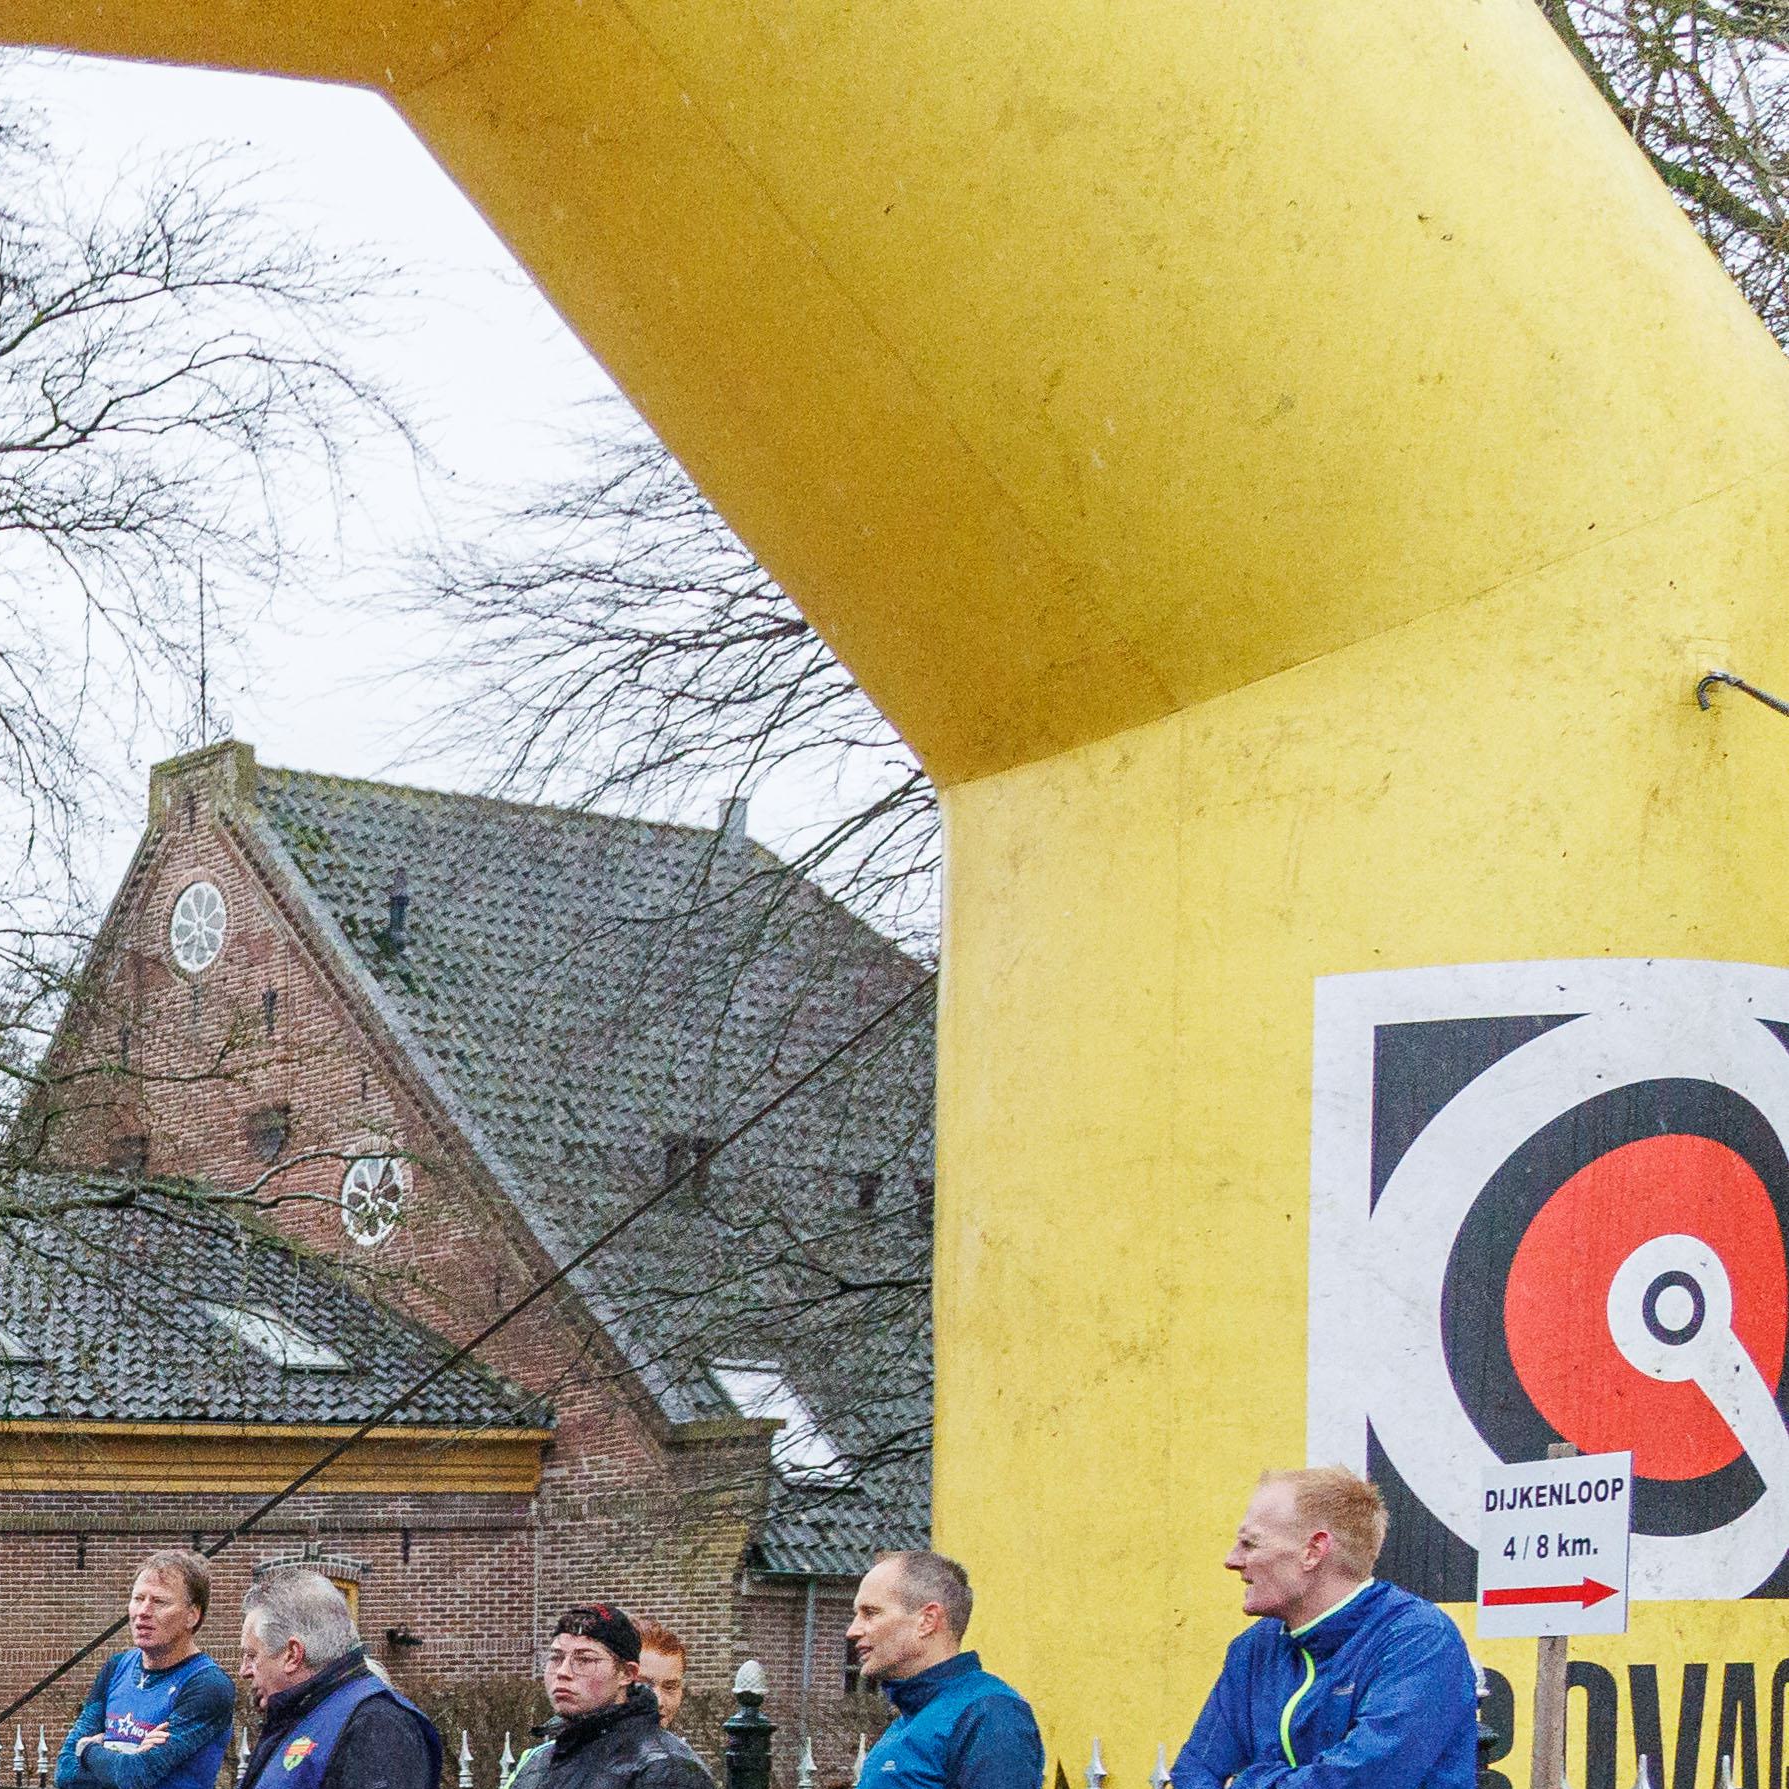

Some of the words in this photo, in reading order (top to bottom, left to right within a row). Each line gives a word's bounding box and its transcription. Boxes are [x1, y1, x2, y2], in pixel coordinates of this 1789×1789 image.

[1484, 1477, 1625, 1513] DIJKENLOOP
[1503, 1535, 1517, 1561] 4
[1536, 1533, 1550, 1560] 8
[1557, 1532, 1599, 1558] km.
